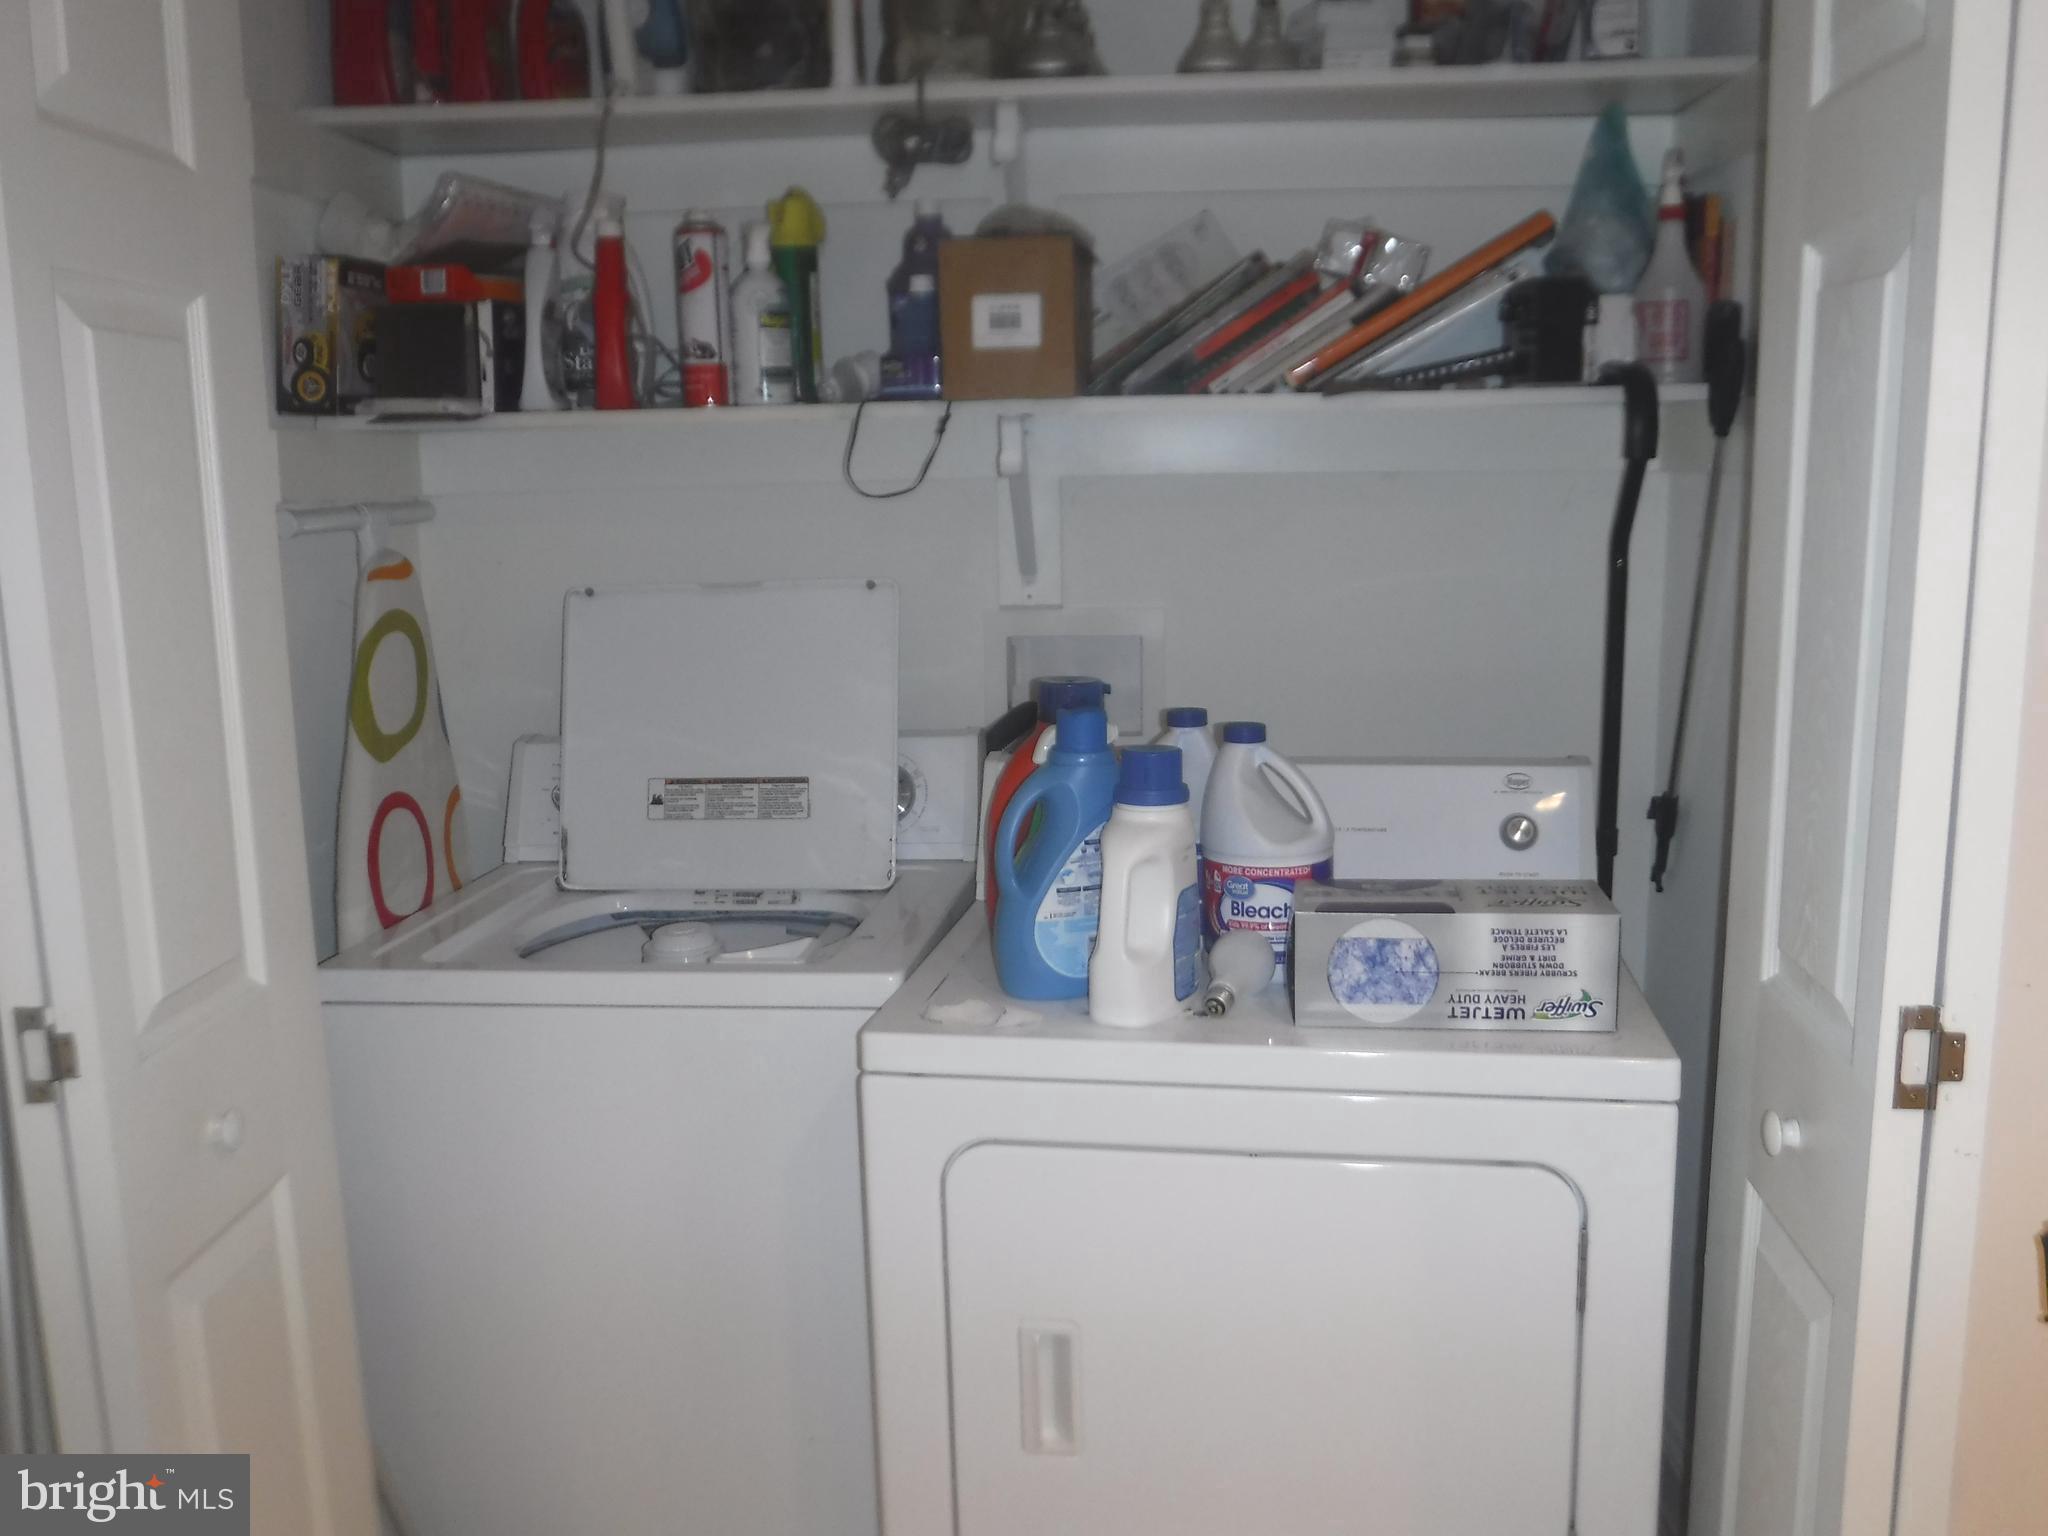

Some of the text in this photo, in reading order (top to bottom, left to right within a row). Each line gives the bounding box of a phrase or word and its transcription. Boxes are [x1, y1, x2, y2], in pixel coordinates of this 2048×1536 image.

[1222, 865, 1243, 875] MORE
[1226, 880, 1248, 890] Great
[1231, 901, 1291, 919] Bleach
[1490, 928, 1522, 936] TENACE
[1509, 943, 1538, 951] FIBRES
[1540, 943, 1556, 951] LES
[1448, 994, 1526, 1005] HEAVY DUTY
[1536, 996, 1604, 1018] Swiffer
[1448, 1006, 1526, 1019] WETJET
